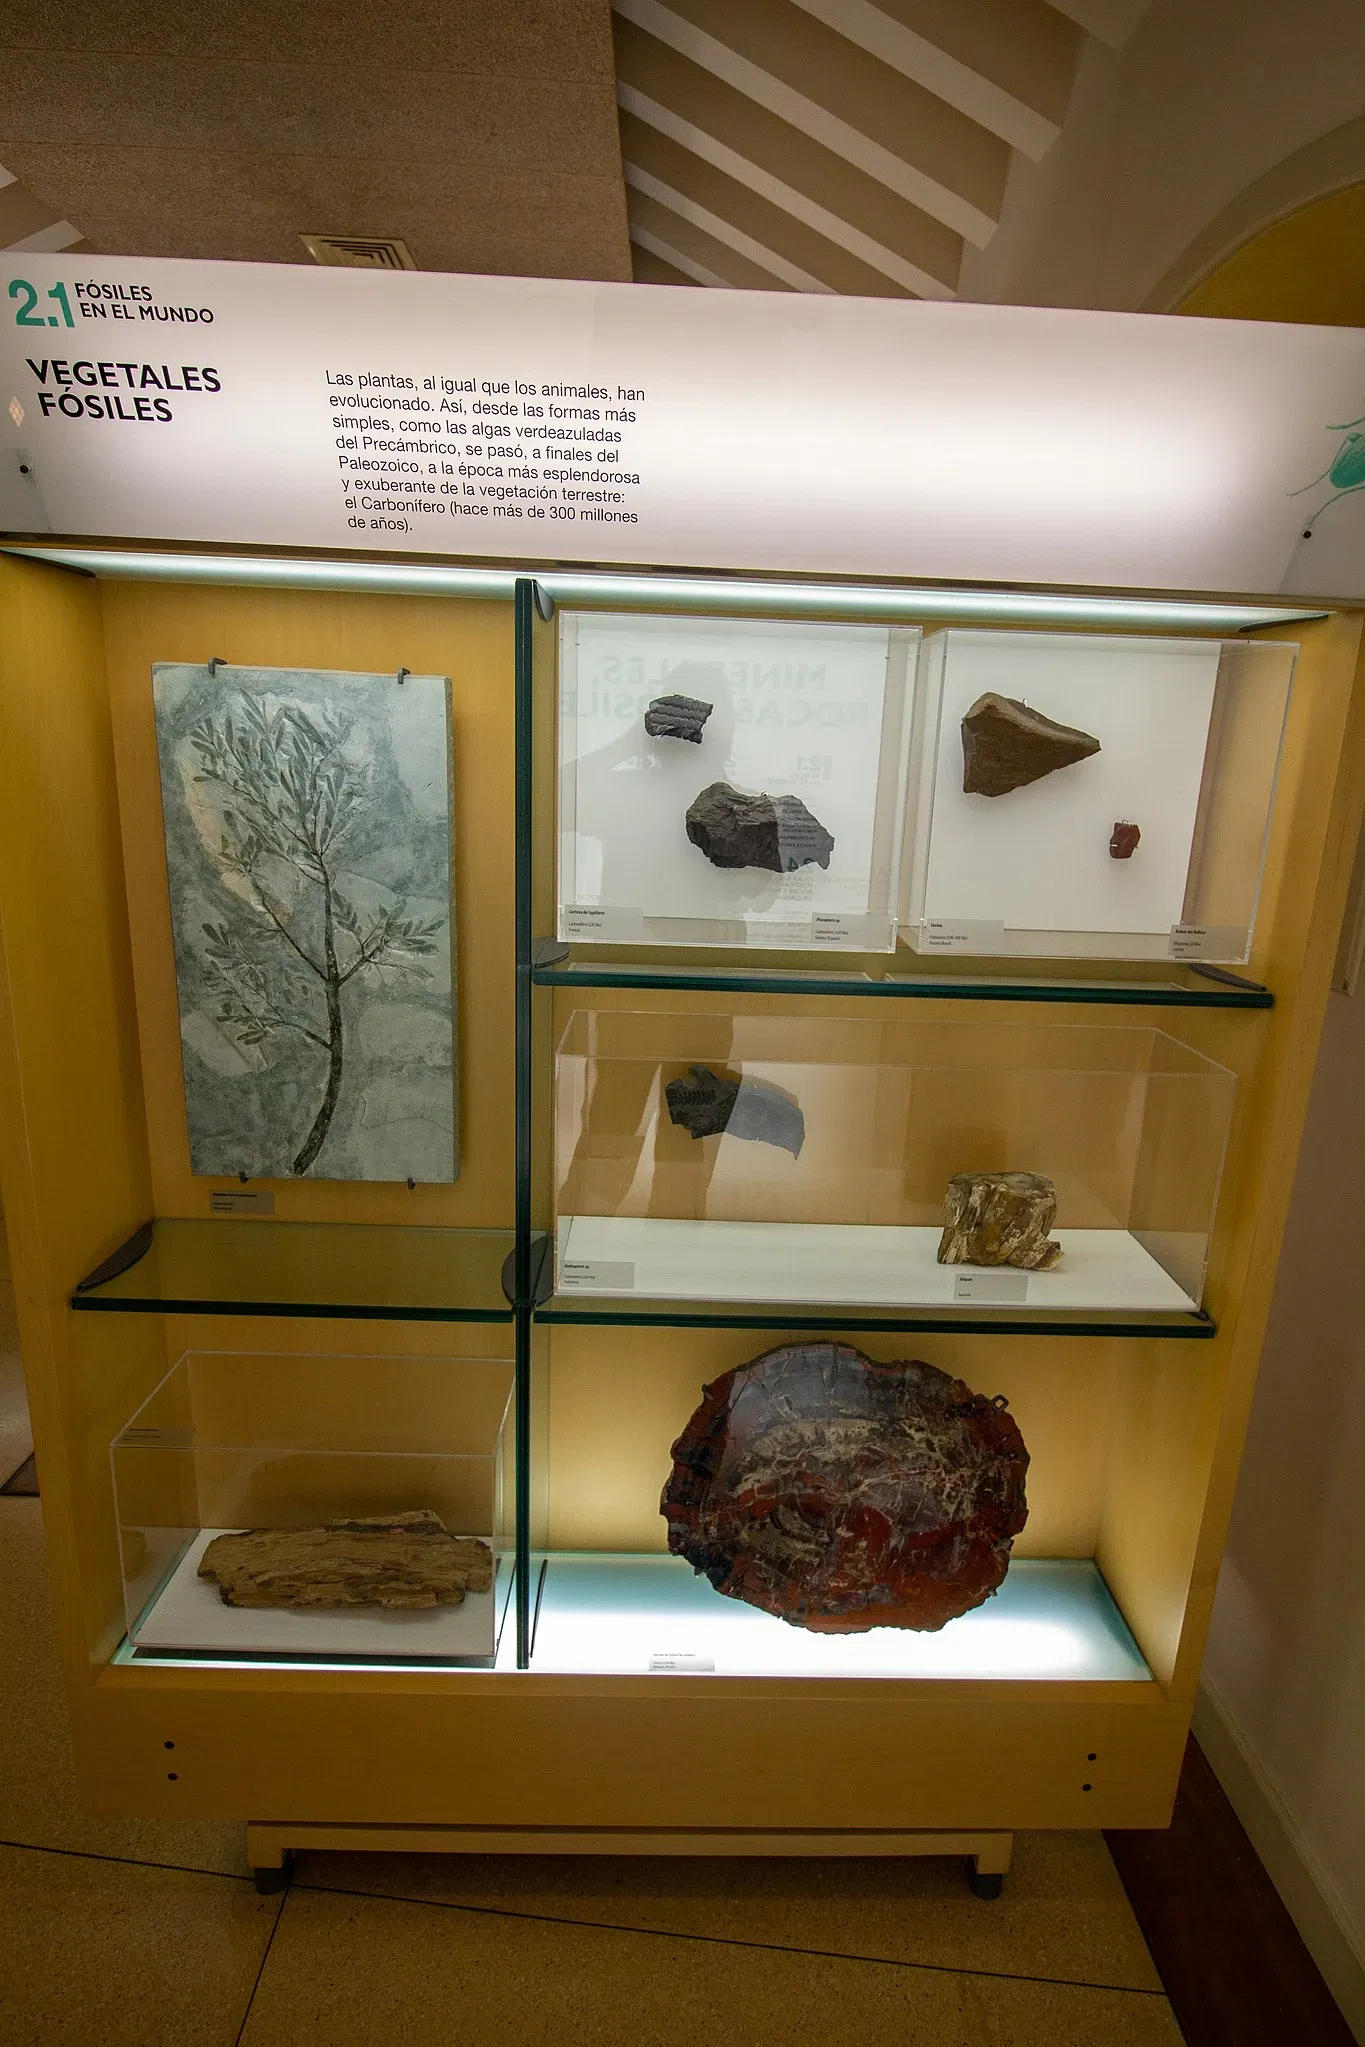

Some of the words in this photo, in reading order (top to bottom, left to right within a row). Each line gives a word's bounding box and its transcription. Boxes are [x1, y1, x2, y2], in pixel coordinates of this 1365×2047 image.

[7, 278, 76, 328] 2.1
[74, 278, 153, 302] FÓSILES
[79, 302, 108, 319] EN
[110, 303, 136, 320] EL
[138, 304, 215, 324] MUNDO
[24, 357, 222, 393] VEGETALES
[325, 369, 354, 387] Las
[358, 371, 419, 392] plantas,
[423, 375, 436, 391] al
[440, 376, 477, 395] igual
[481, 380, 510, 397] que
[514, 379, 537, 396] los
[541, 382, 613, 402] animales,
[617, 385, 646, 402] han
[36, 386, 173, 423] FÓSILES
[329, 393, 436, 412] evolucionado.
[439, 397, 467, 416] Así,
[471, 399, 519, 417] desde
[523, 402, 545, 418] las
[548, 403, 601, 421] formas
[604, 407, 637, 423] más
[332, 414, 395, 433] simples,
[399, 420, 442, 434] como
[445, 419, 467, 436] las
[471, 420, 511, 440] algas
[515, 424, 622, 443] verdeazuladas
[335, 434, 358, 450] del
[362, 436, 462, 457] Precámbrico,
[465, 444, 483, 456] se
[487, 443, 528, 461] pasó,
[531, 448, 542, 460] a
[545, 445, 593, 462] finales
[596, 448, 620, 464] del
[338, 455, 424, 476] Paleozoico,
[427, 462, 438, 475] a
[441, 460, 454, 476] la
[458, 461, 504, 479] época
[508, 464, 539, 480] más
[542, 467, 641, 485] esplendorosa
[341, 478, 350, 493] y
[354, 477, 436, 494] exuberante
[439, 481, 459, 495] de
[462, 481, 476, 497] la
[479, 485, 558, 501] vegetación
[561, 487, 626, 504] terrestre:
[344, 495, 357, 510] el
[361, 495, 446, 514] Carbonífero
[449, 500, 489, 518] (hace
[492, 503, 523, 518] más
[526, 504, 546, 519] de
[549, 505, 576, 520] 300
[580, 508, 639, 524] millones
[347, 515, 366, 529] de
[370, 516, 413, 534] años).
